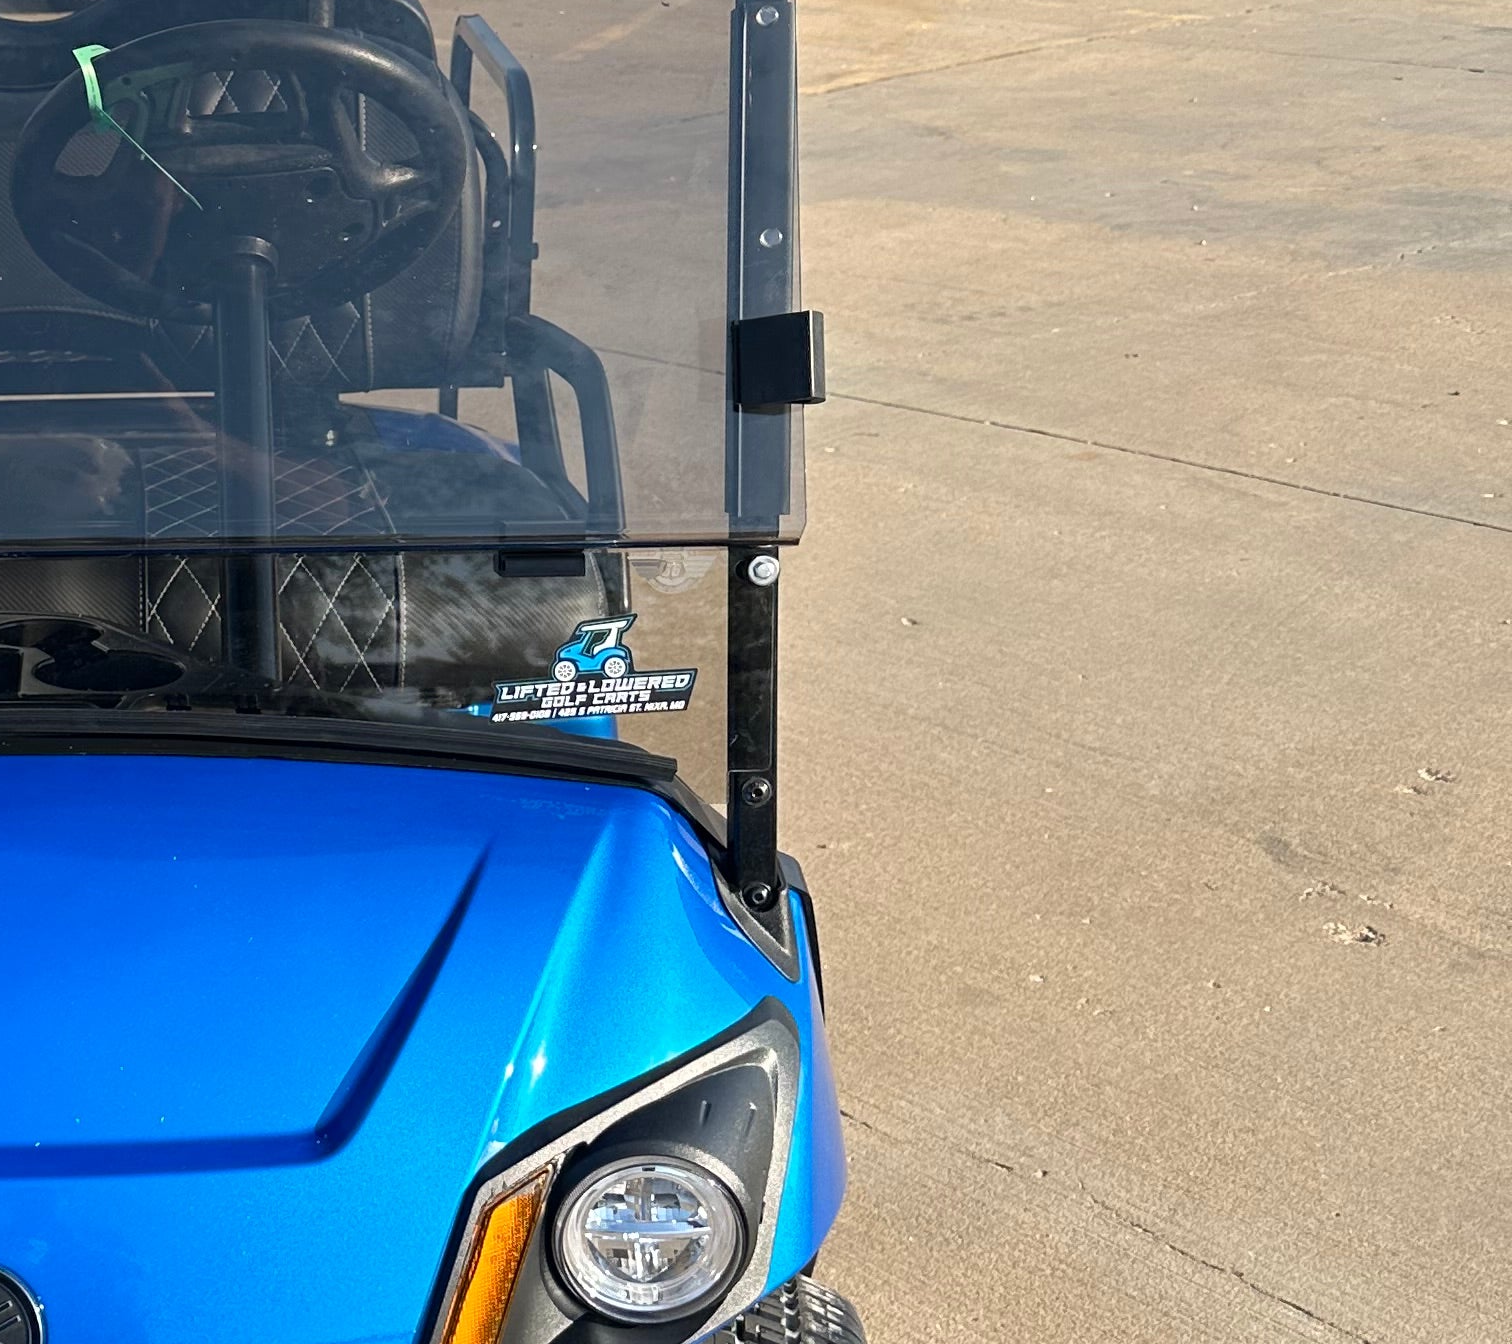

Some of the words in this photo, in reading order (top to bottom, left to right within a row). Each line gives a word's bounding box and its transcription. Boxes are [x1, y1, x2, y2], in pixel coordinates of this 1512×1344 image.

[501, 682, 575, 700] LIFTED
[588, 675, 691, 693] LOWERED
[541, 694, 588, 709] GOLF
[593, 690, 651, 705] CARTS
